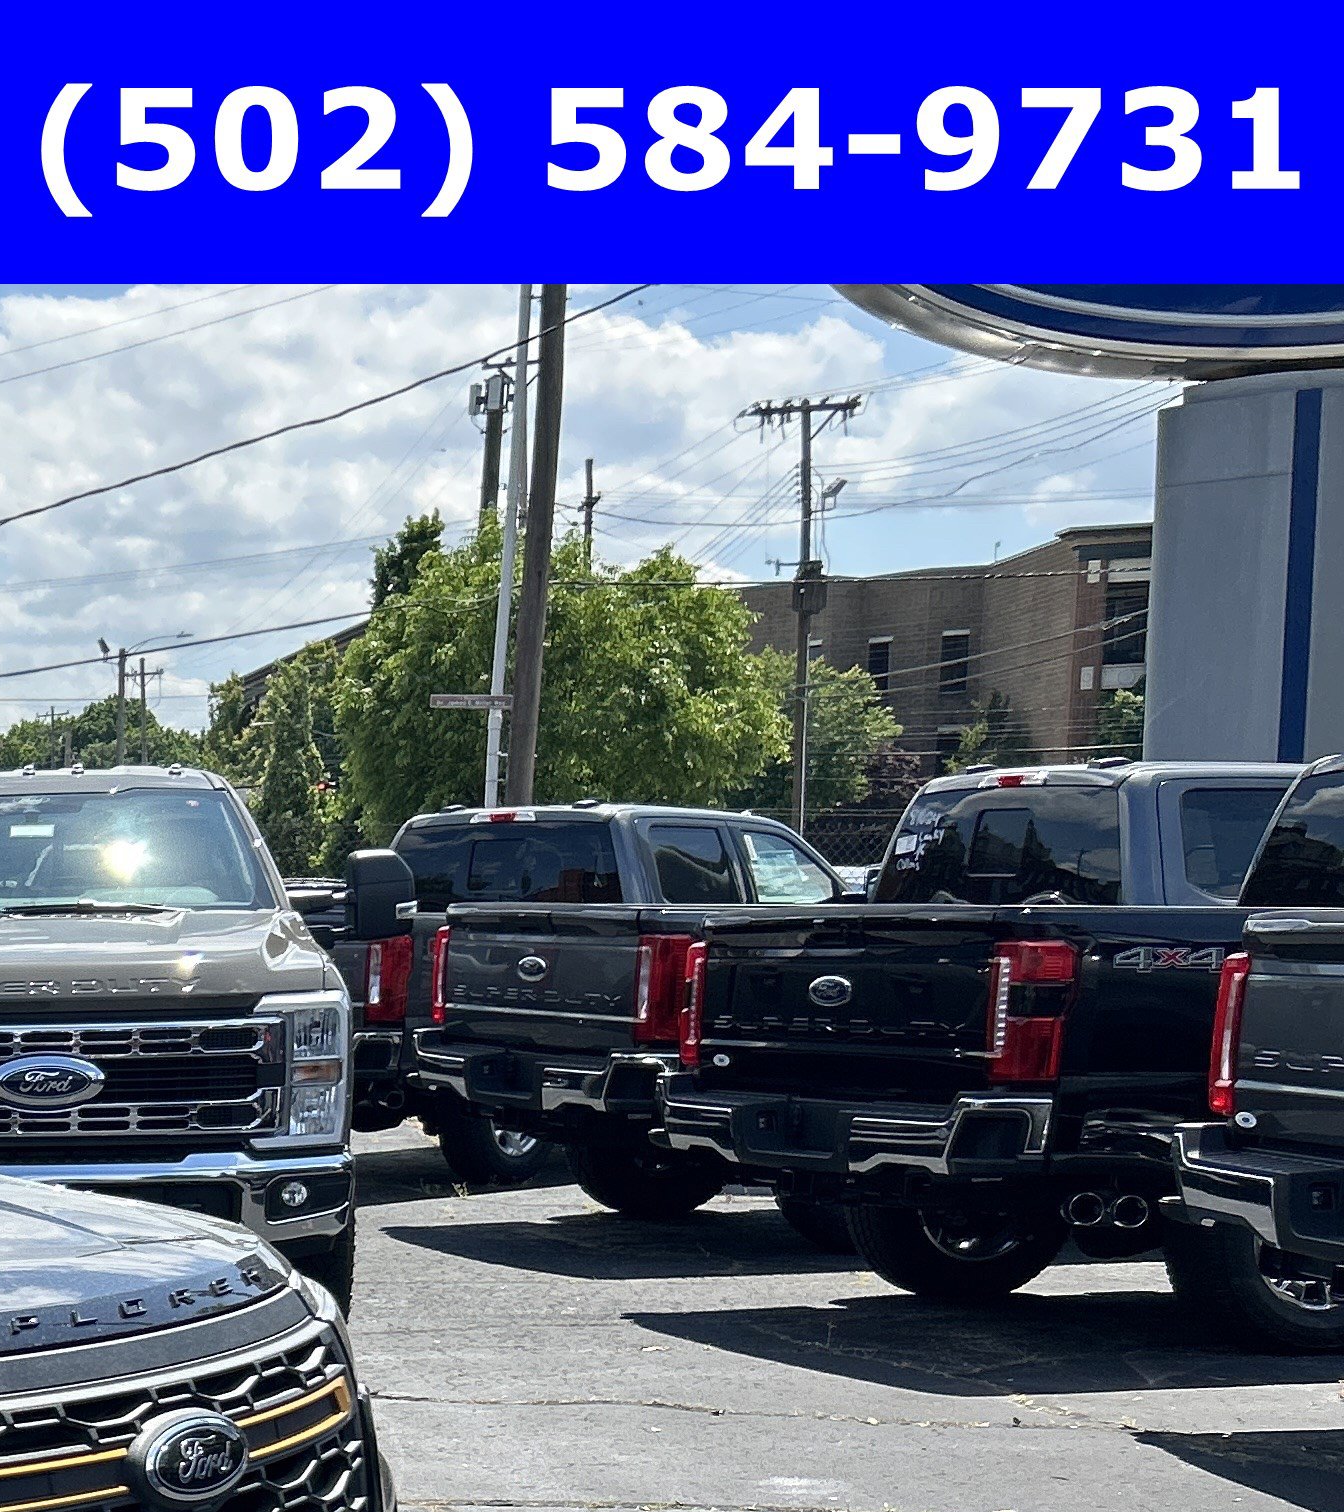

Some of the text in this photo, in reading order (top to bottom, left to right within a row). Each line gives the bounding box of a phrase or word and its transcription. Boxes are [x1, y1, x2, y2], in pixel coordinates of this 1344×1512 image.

[1113, 946, 1225, 973] 4x4
[70, 977, 201, 995] DUTY
[19, 1070, 73, 1093] Ford
[178, 1434, 233, 1484] Ford
